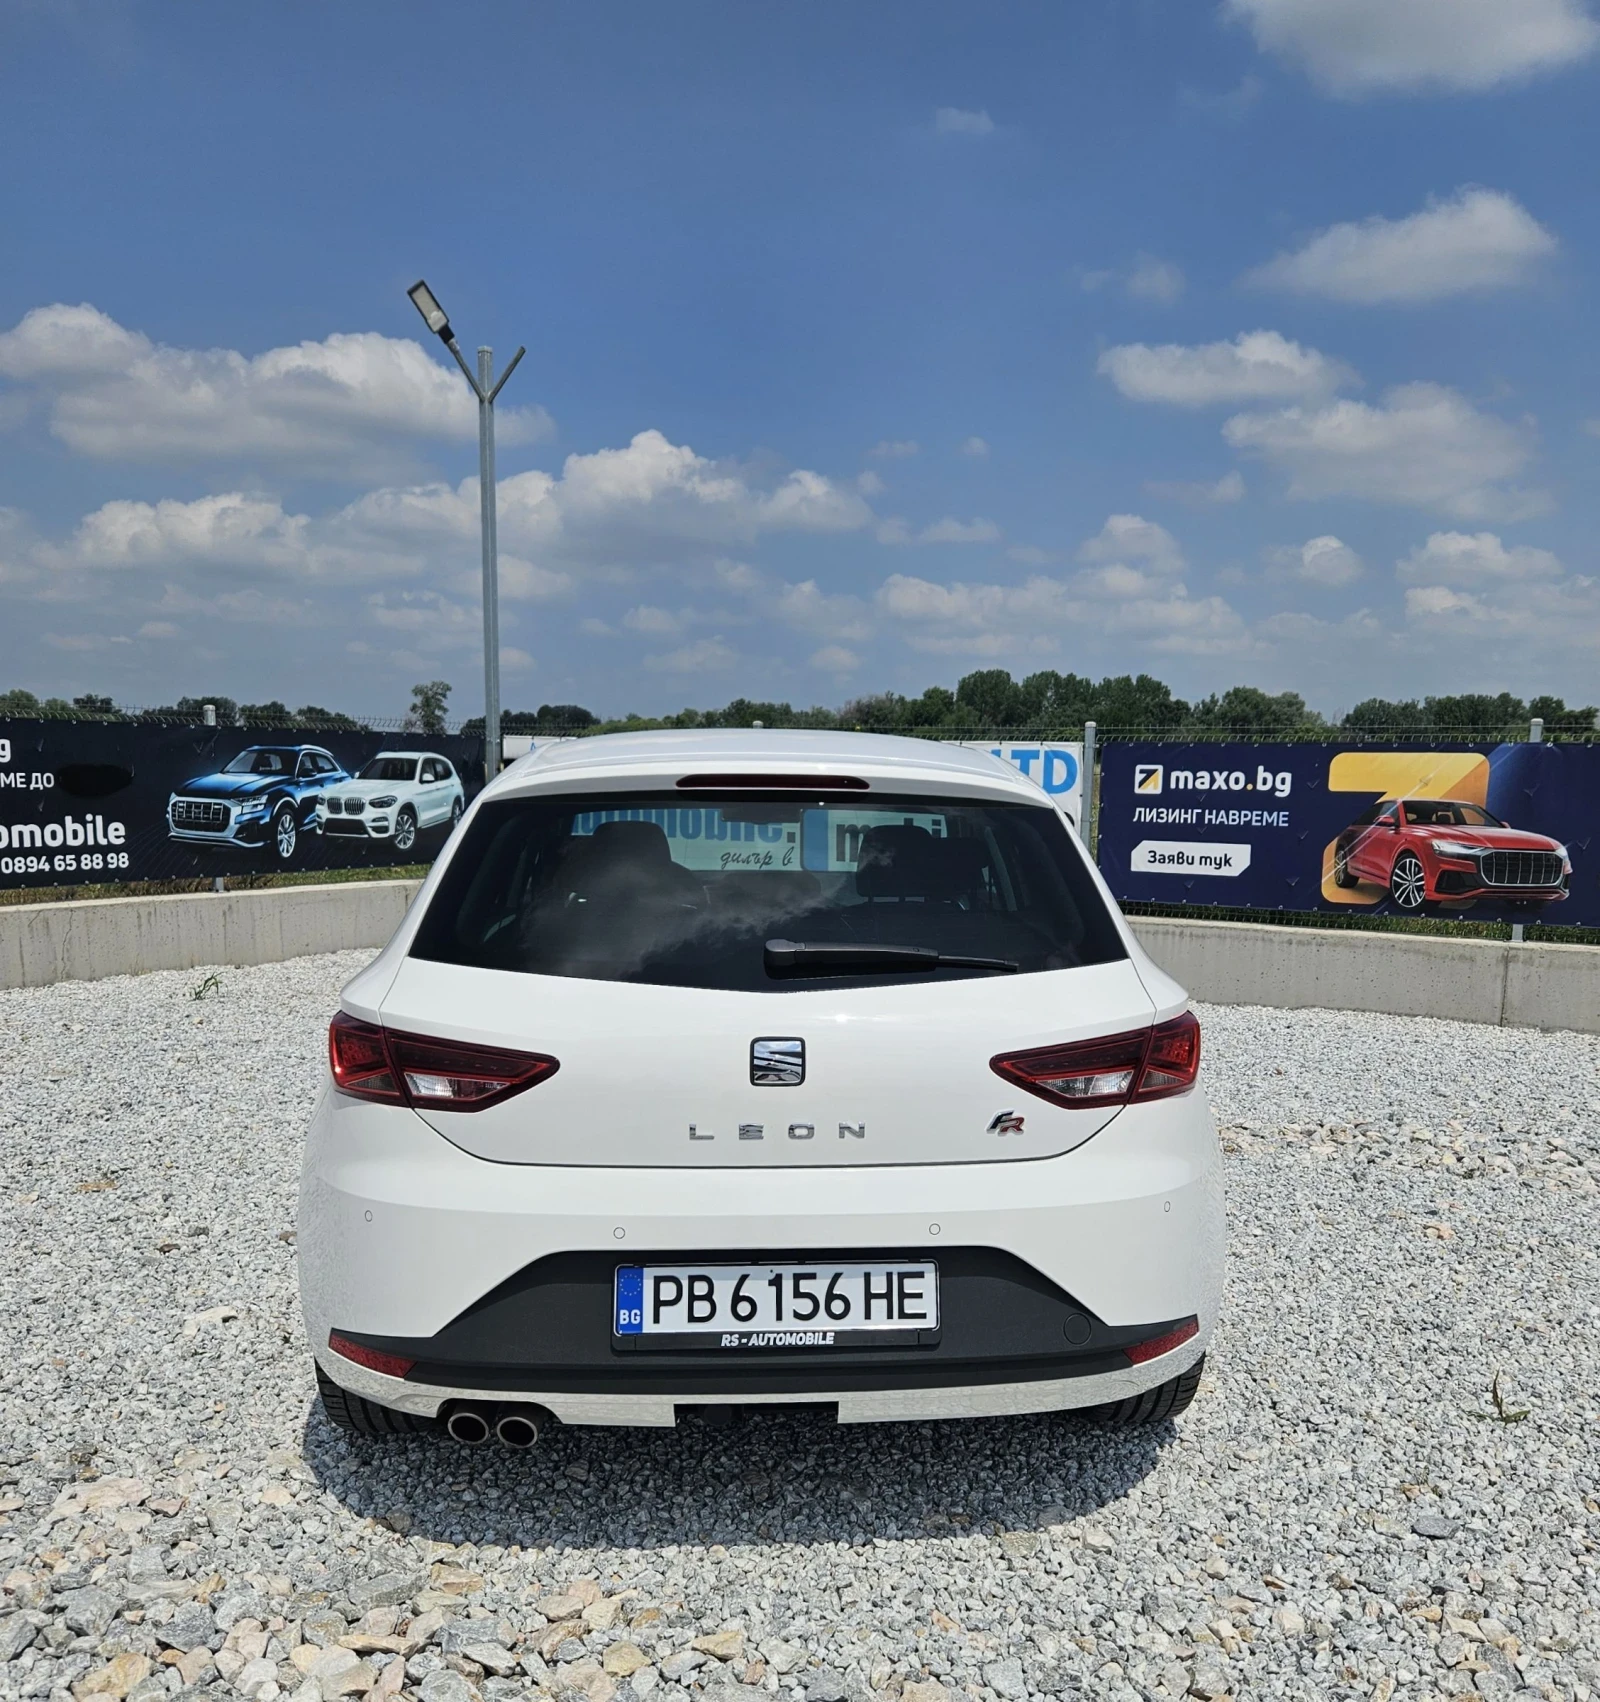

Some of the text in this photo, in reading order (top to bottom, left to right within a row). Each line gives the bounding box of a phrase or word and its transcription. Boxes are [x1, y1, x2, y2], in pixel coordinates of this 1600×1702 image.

[30, 772, 55, 790] ДО
[991, 749, 1078, 794] TD
[1170, 765, 1292, 797] maxo.bg
[1133, 807, 1290, 827] ЛИЗИНГ НАВРЕМЕ
[1, 852, 130, 874] 0894 65 88 98
[1147, 850, 1233, 870] Заяви тук
[689, 1122, 866, 1140] LEON
[653, 1271, 928, 1324] PB 6156 HE
[619, 1310, 641, 1325] BG
